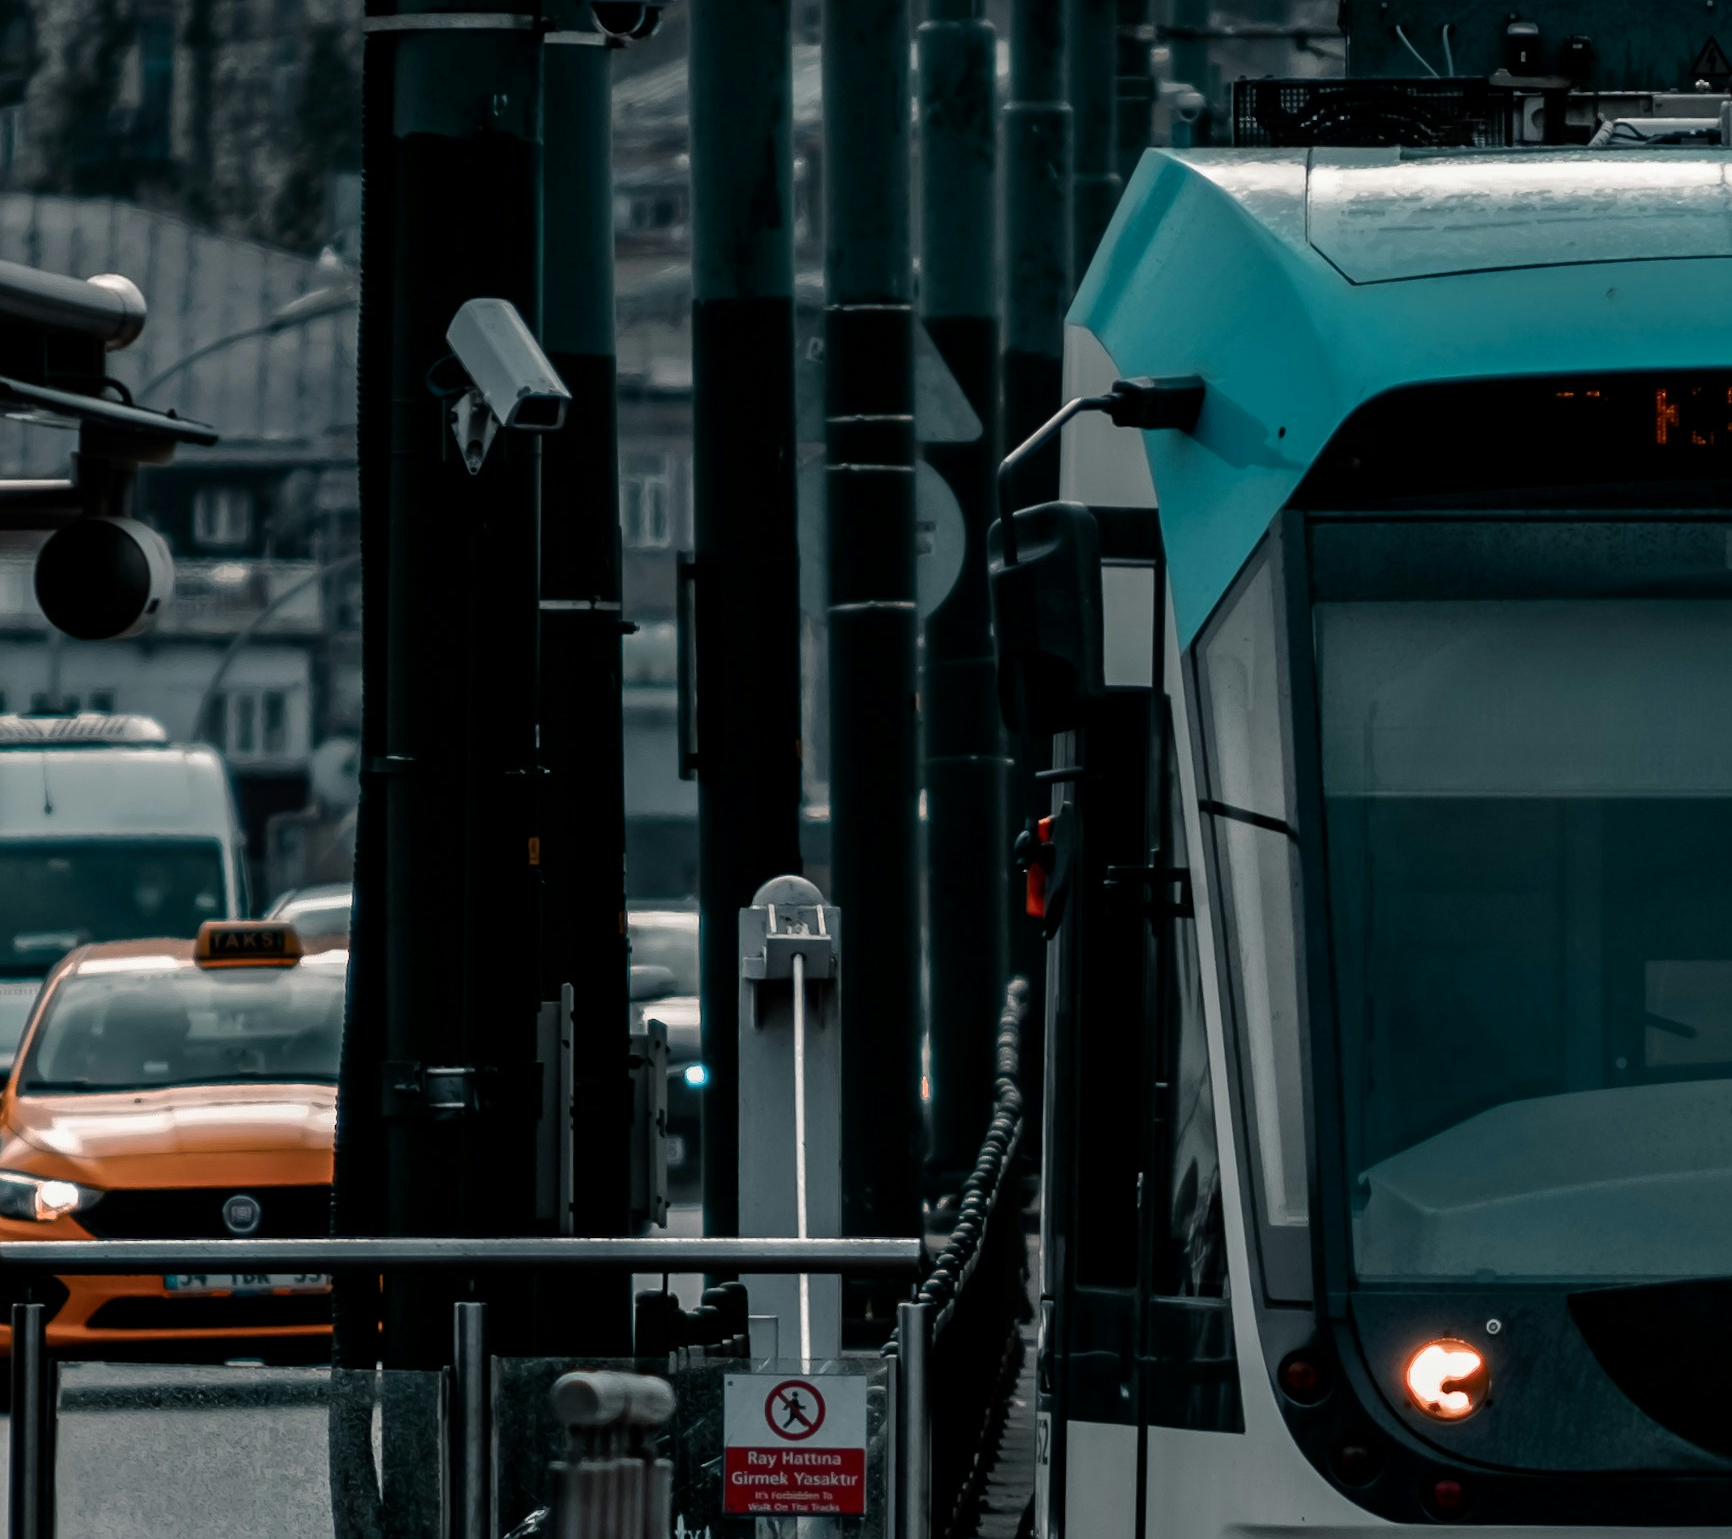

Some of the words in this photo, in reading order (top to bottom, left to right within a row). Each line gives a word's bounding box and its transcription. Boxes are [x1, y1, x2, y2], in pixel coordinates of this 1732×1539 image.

[747, 1450, 777, 1469] Ray
[782, 1451, 842, 1466] Hattına
[731, 1470, 789, 1486] Girmek
[794, 1471, 859, 1487] Yasaktır
[823, 1490, 834, 1500] To
[774, 1503, 789, 1512] On
